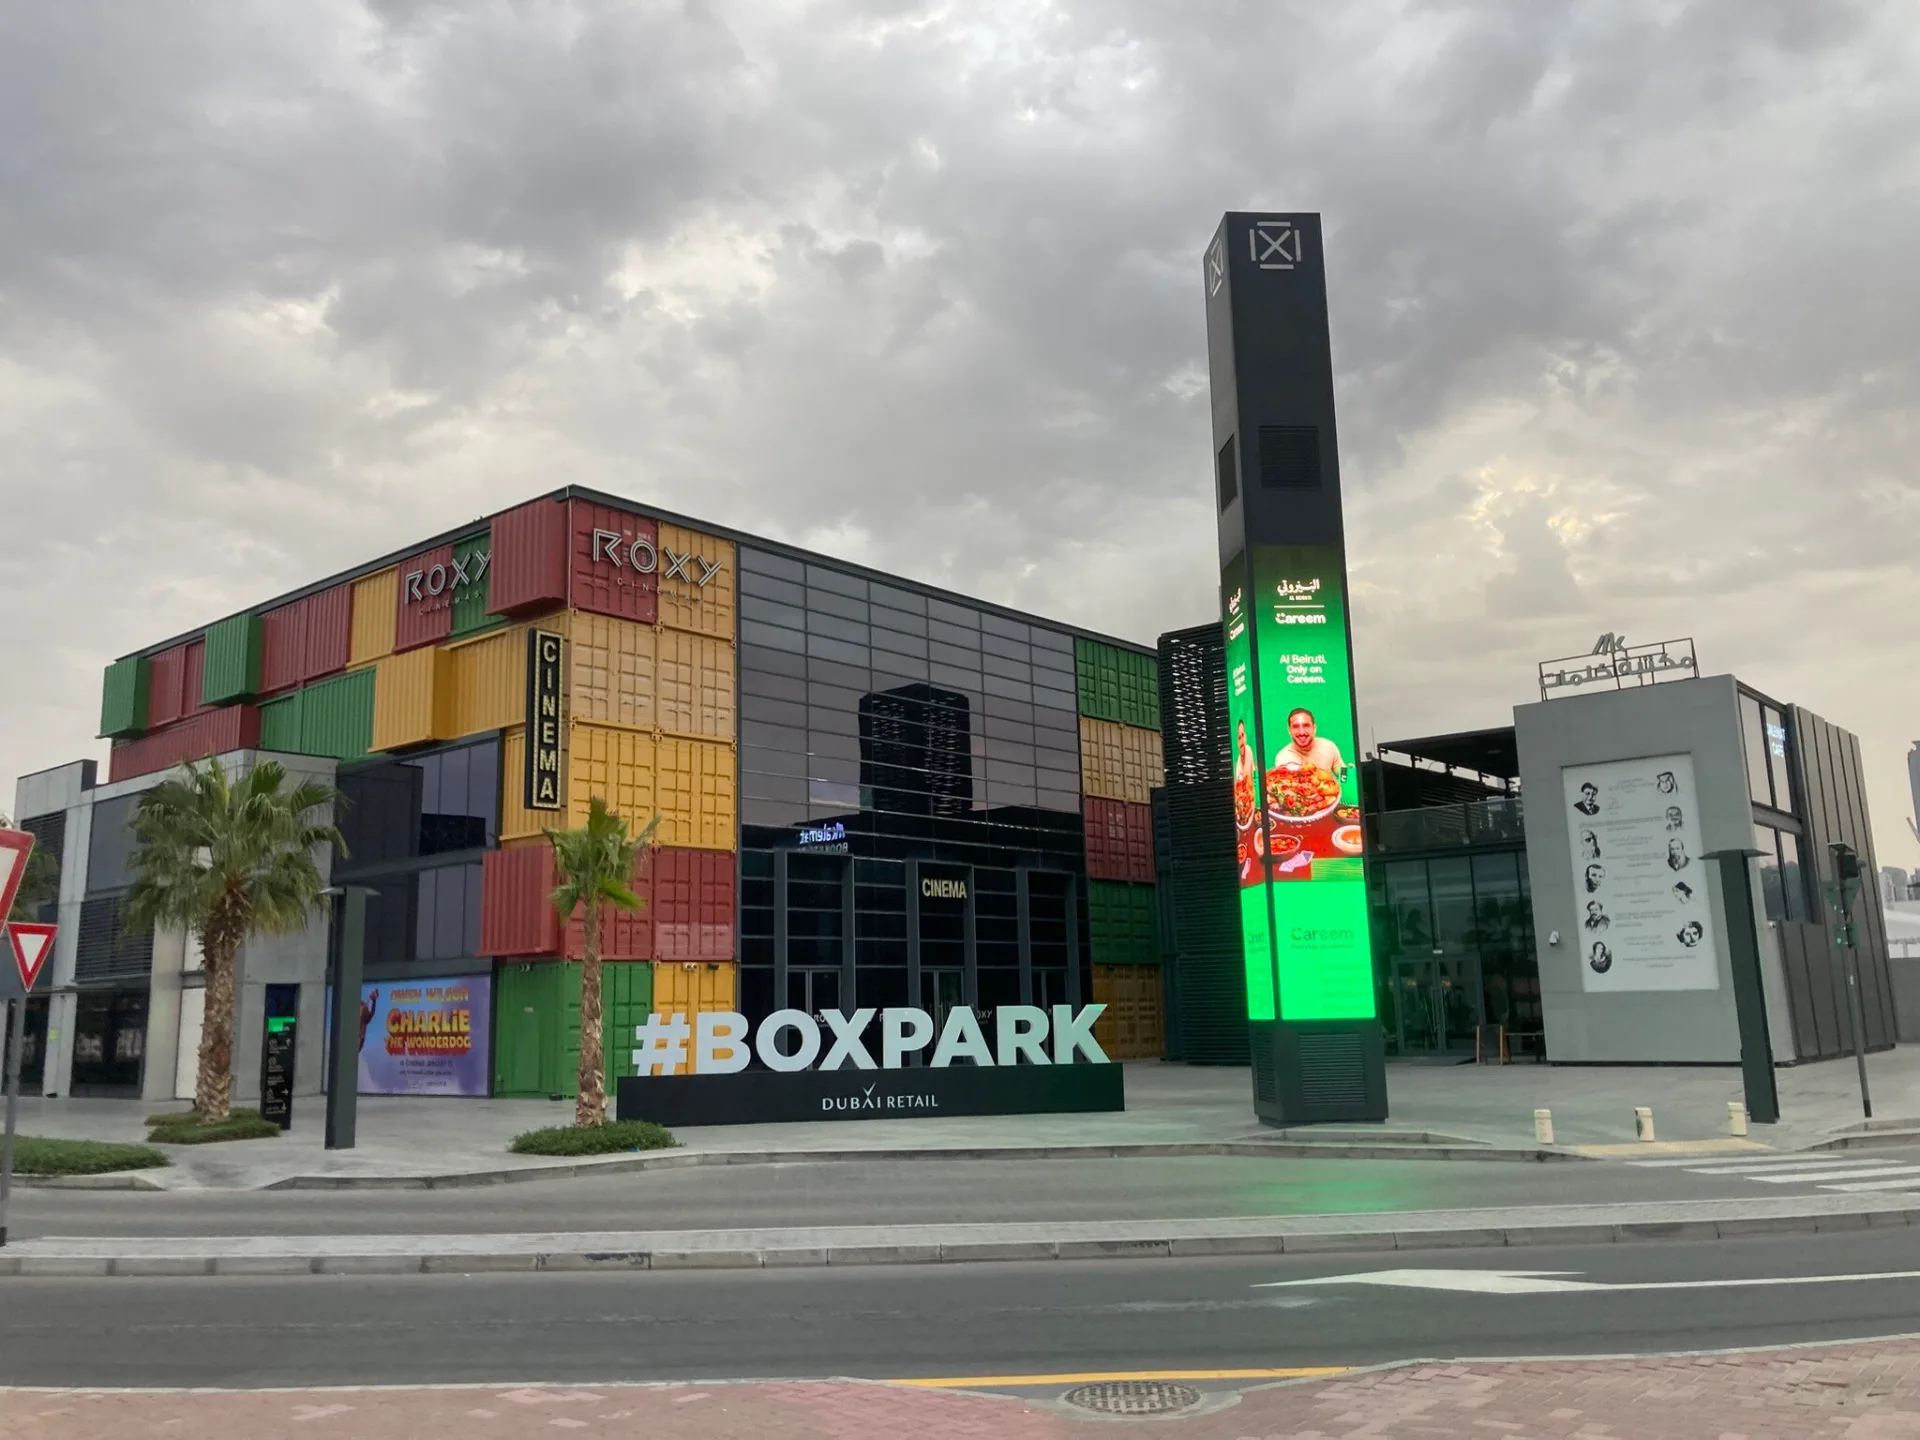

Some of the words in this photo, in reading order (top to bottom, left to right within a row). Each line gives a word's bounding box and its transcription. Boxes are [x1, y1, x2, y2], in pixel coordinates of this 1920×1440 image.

[593, 528, 723, 587] ROXY
[404, 550, 491, 605] ROXY
[617, 577, 703, 605] CINEMAS
[1275, 612, 1327, 625] Careem
[1286, 665, 1308, 676] Only
[1310, 666, 1323, 674] on
[1539, 662, 1616, 689] كلمات
[1618, 653, 1694, 681] مكتبة
[539, 641, 558, 800] CINEMA
[921, 877, 967, 899] CINEMA
[1291, 928, 1355, 941] Careem
[426, 986, 469, 1001] WILSON
[406, 1035, 472, 1049] WONDERDOG
[632, 1003, 1111, 1077] #BOXPARK
[822, 1081, 881, 1111] DUBAI
[887, 1094, 938, 1109] RETAIL
